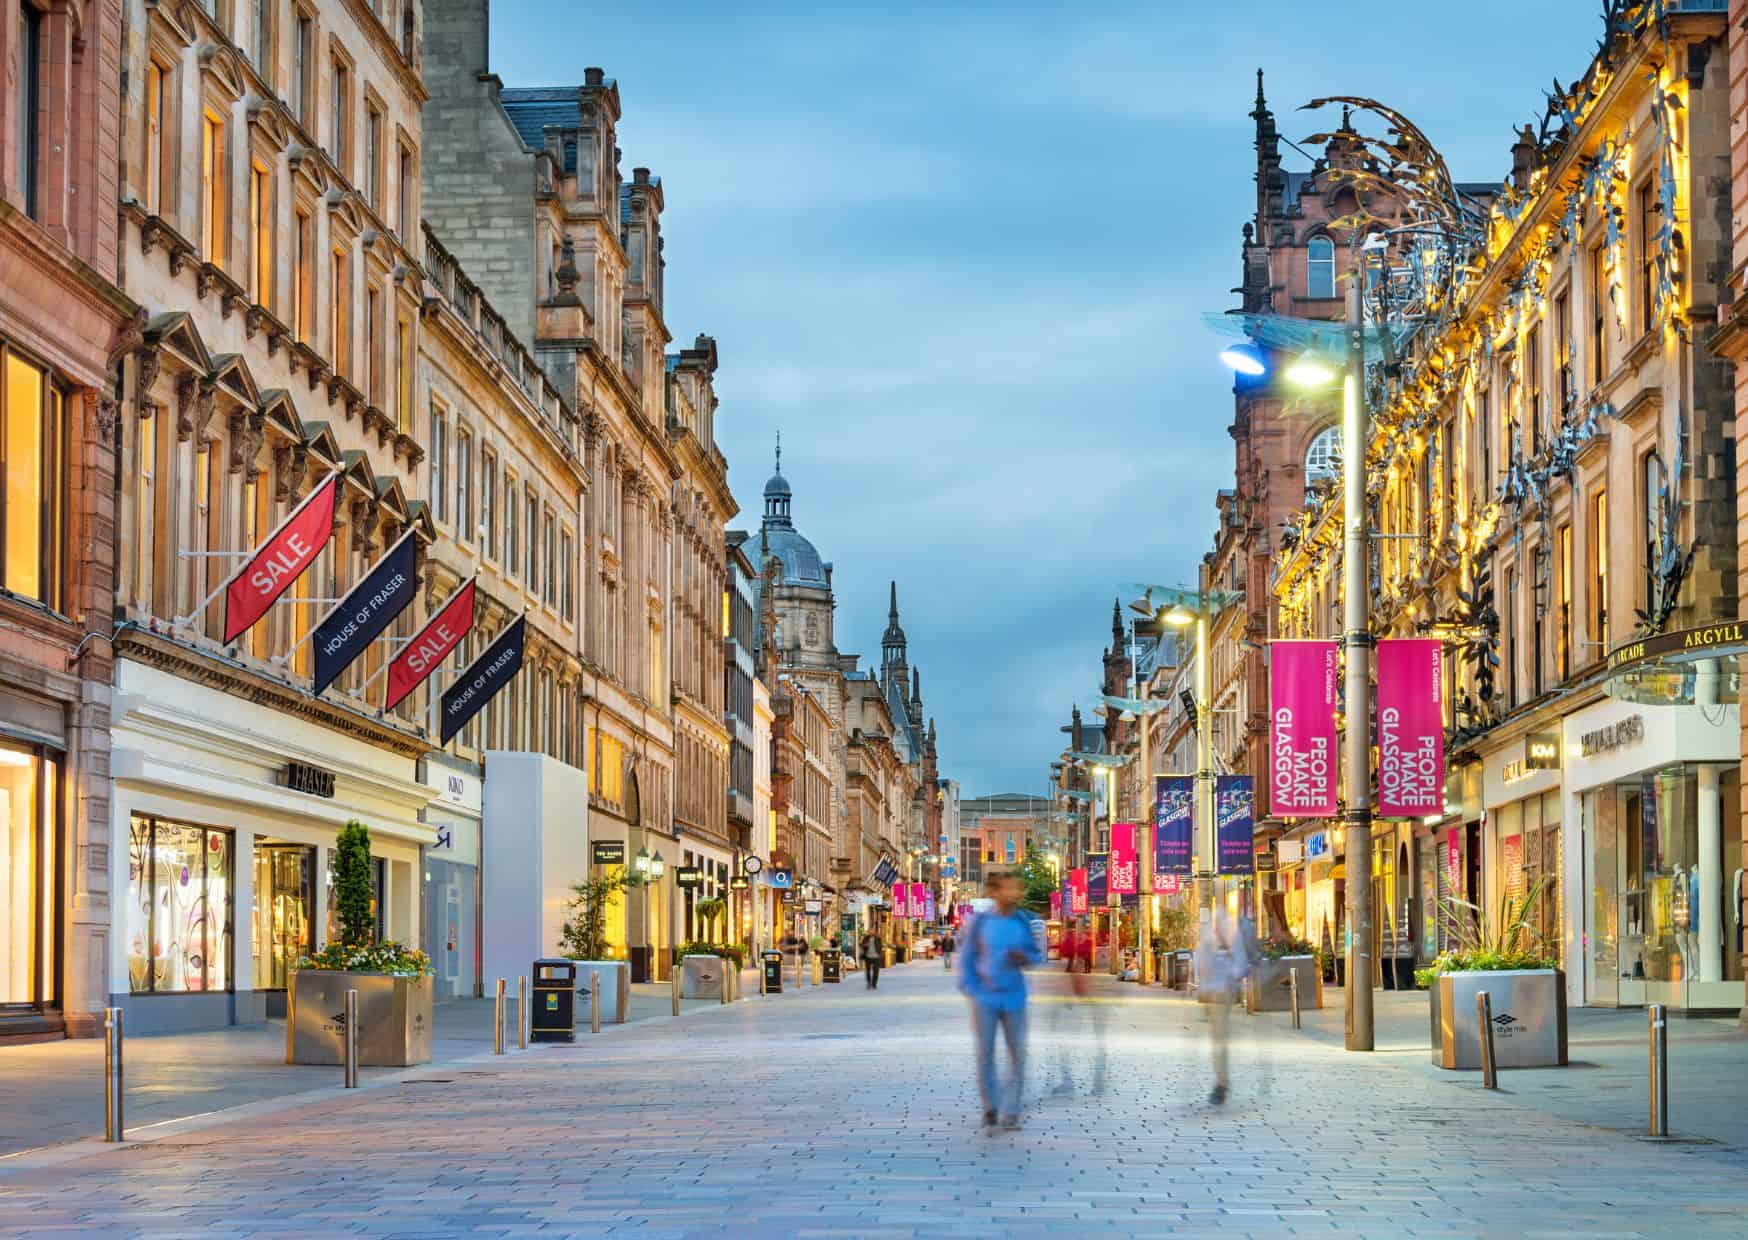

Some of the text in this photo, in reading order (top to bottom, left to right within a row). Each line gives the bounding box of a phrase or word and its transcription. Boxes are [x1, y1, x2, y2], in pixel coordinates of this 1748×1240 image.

[251, 532, 312, 595] SALE
[323, 573, 406, 656] HOUSE OF FRASER
[1684, 625, 1743, 648] ARGYLL
[407, 623, 456, 673] SALE
[1432, 649, 1440, 666] Let's
[1617, 642, 1645, 664] ARCADE
[448, 648, 516, 715] HOUSE OF FRASER
[1275, 707, 1293, 807] GLASGOW
[1293, 752, 1309, 807] MAKE
[1311, 737, 1328, 807] PEOPLE
[1382, 707, 1400, 806] GLASGOW
[1401, 751, 1418, 806] MAKE
[1418, 736, 1436, 806] PEOPLE
[448, 775, 464, 794] KIKO
[1158, 805, 1189, 828] GLASGOW
